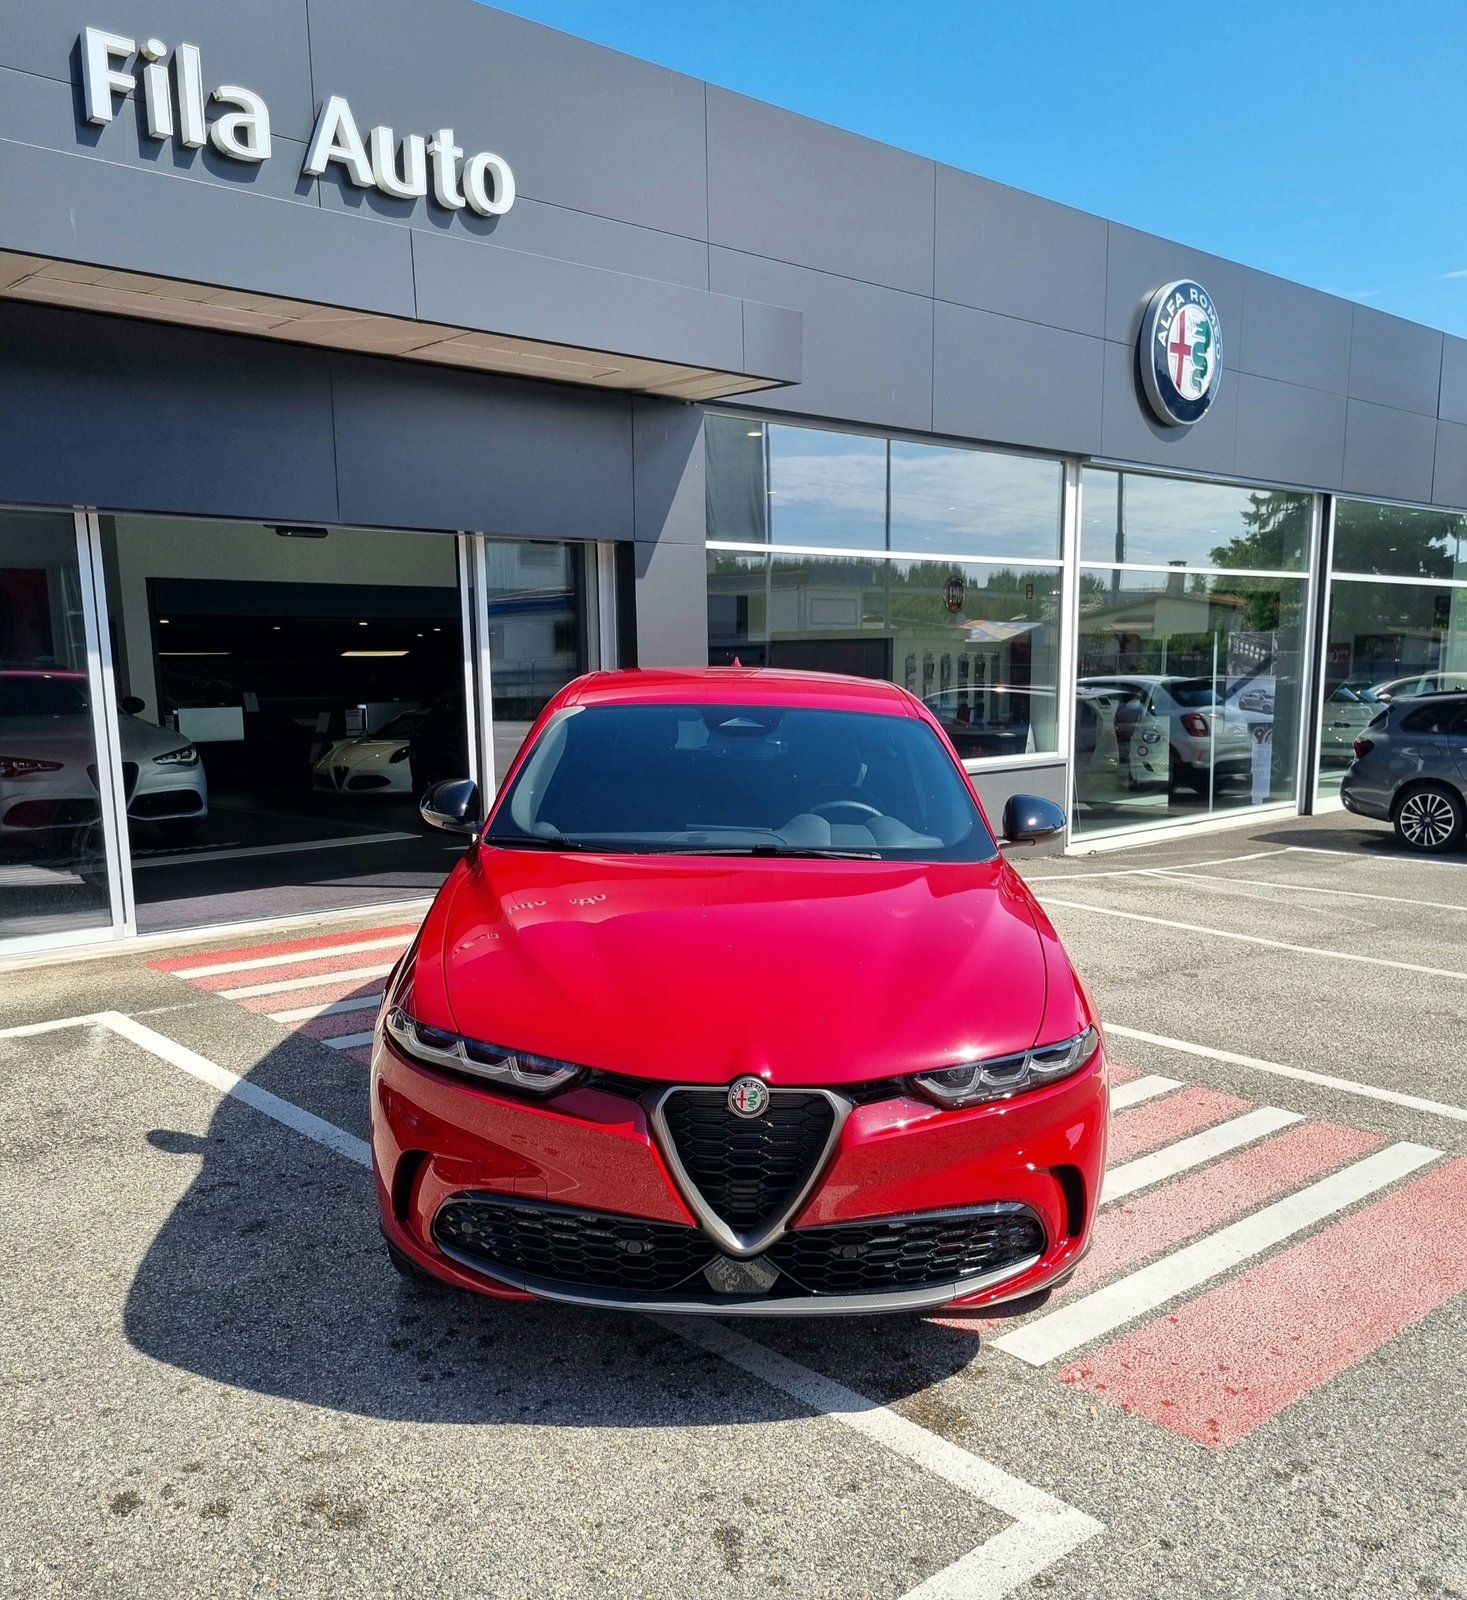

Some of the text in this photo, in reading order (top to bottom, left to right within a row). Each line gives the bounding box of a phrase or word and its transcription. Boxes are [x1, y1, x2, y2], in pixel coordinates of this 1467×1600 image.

[84, 26, 516, 218] Fila Auto
[1157, 287, 1221, 361] ALFA ROMEO
